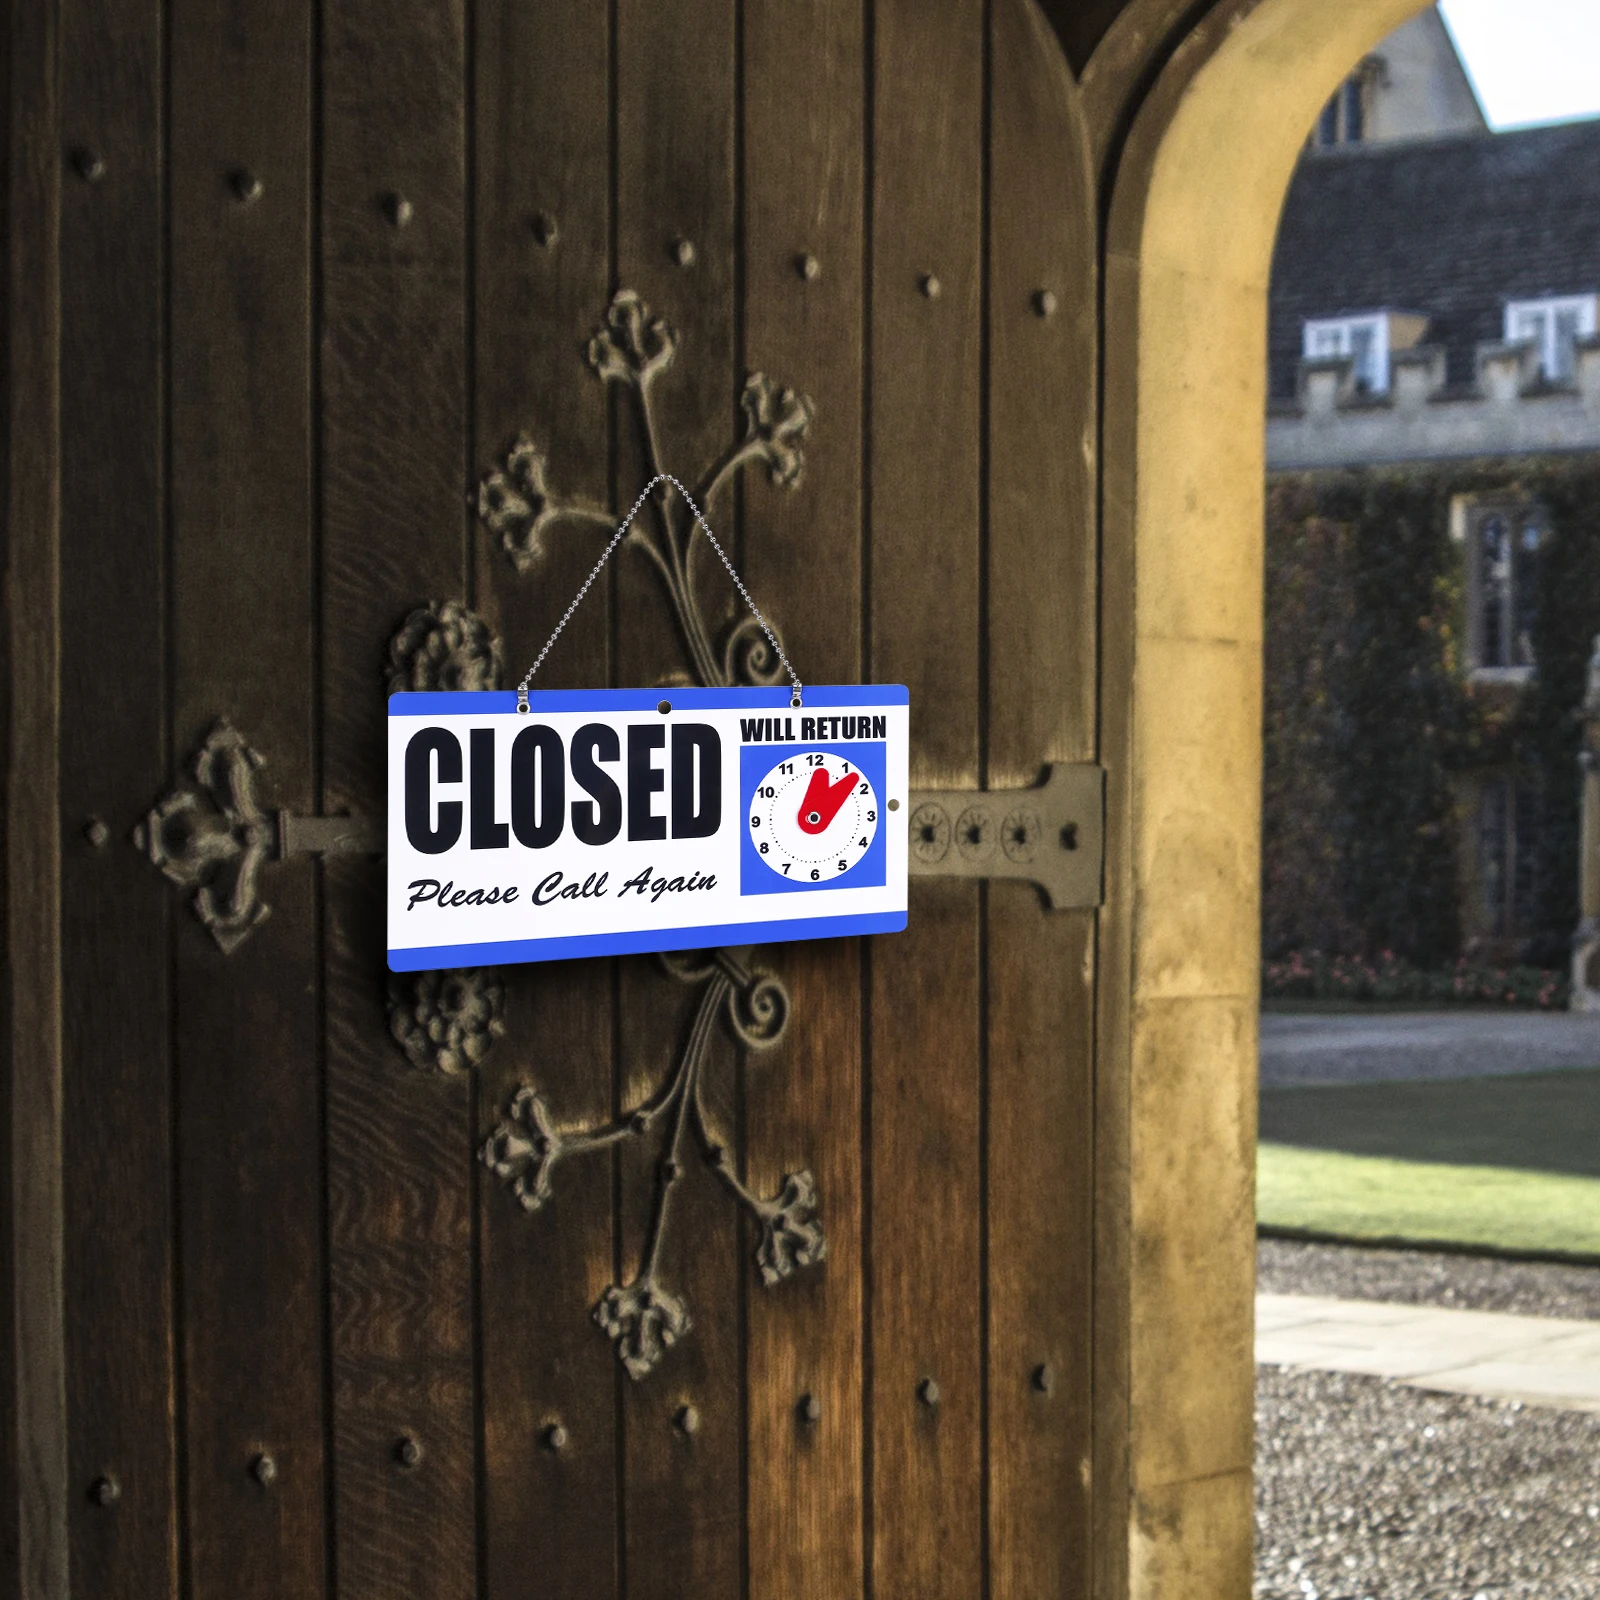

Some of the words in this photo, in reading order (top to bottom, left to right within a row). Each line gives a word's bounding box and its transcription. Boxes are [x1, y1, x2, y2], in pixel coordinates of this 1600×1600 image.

[739, 717, 795, 742] WILL
[801, 715, 886, 740] RETURN
[805, 754, 824, 766] 12
[778, 763, 793, 774] 11
[841, 762, 848, 773] 1
[404, 722, 722, 854] CLOSED
[757, 786, 774, 798] 10
[859, 783, 868, 794] 2
[751, 815, 760, 827] 9
[866, 810, 876, 821] 3
[858, 836, 867, 847] 4
[759, 842, 769, 853] 8
[781, 863, 791, 874] 7
[837, 859, 847, 870] 5
[810, 868, 819, 880] 6
[406, 877, 519, 912] Please
[531, 870, 608, 906] Call
[617, 866, 718, 902] Again
